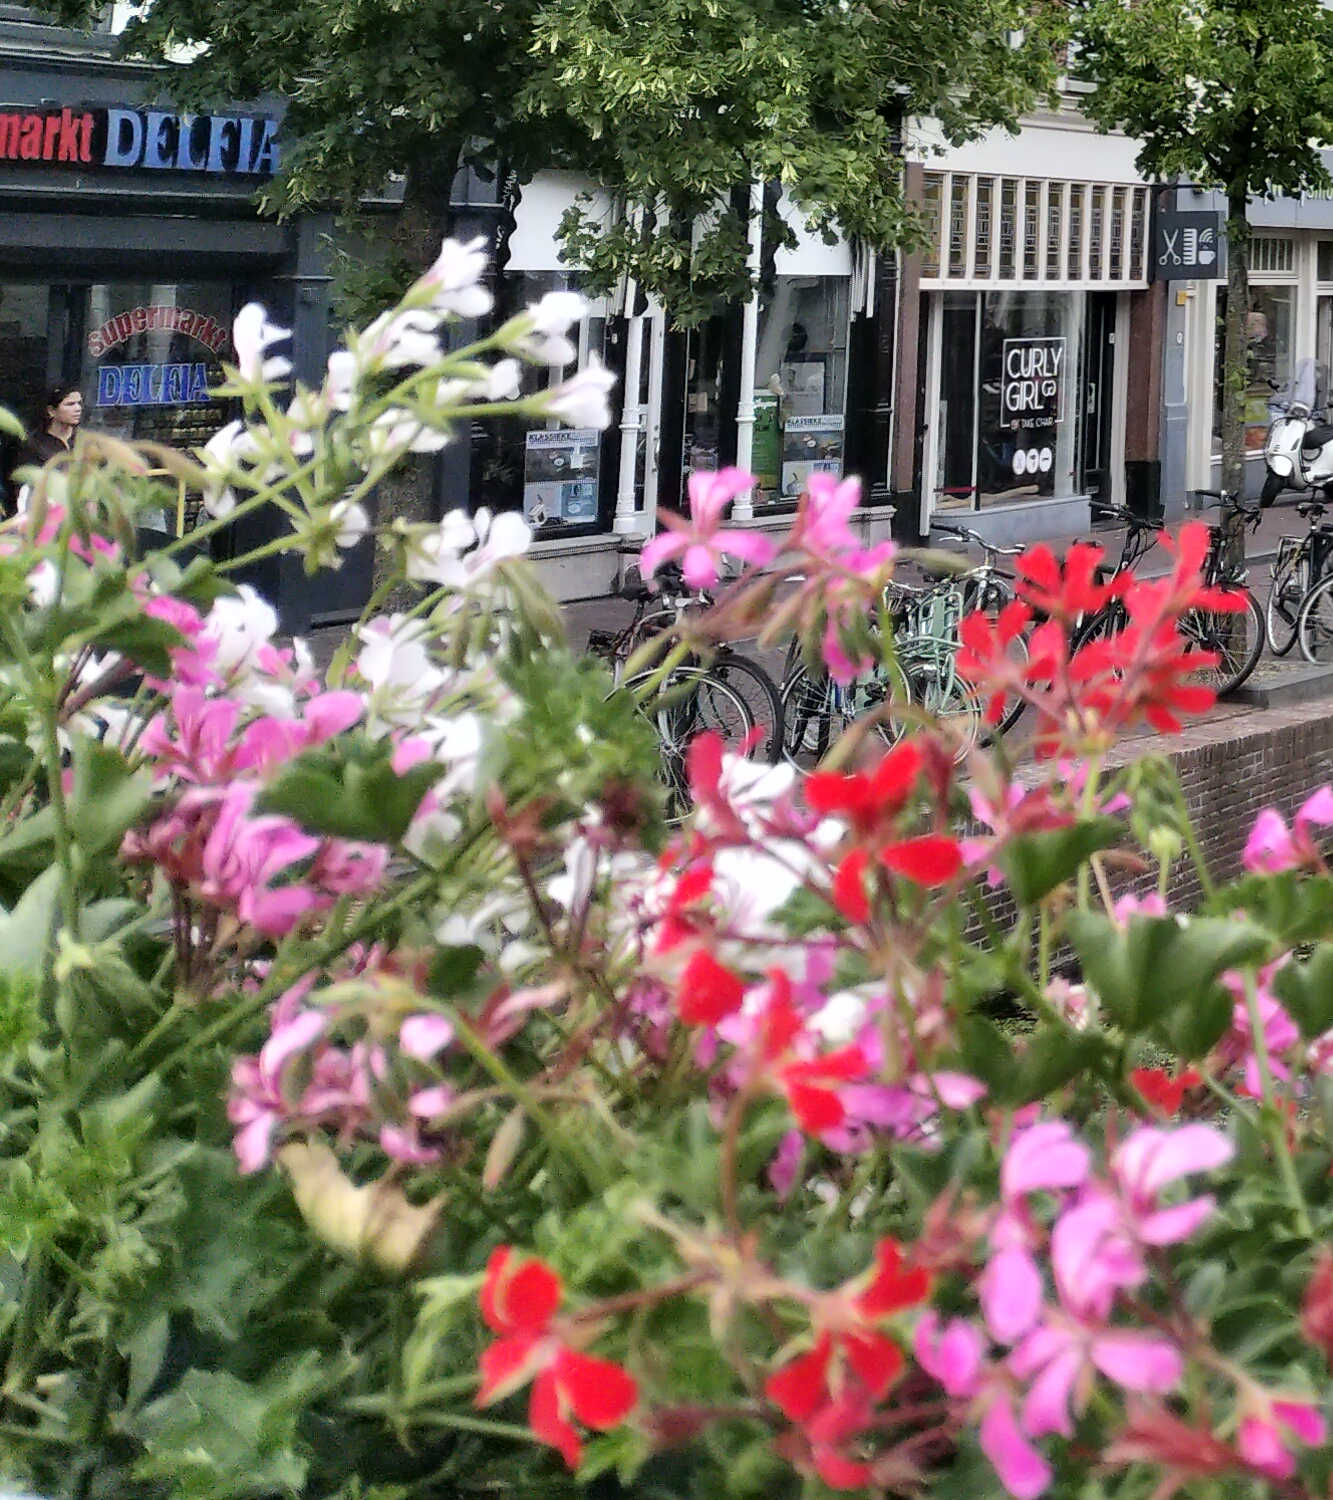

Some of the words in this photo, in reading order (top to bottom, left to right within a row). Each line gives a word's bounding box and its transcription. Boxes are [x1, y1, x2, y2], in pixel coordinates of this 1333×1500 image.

[102, 108, 282, 175] DELFIA
[88, 304, 228, 357] supermarkt
[96, 362, 212, 407] DELFIA
[1007, 347, 1063, 379] CURLY
[1005, 380, 1044, 412] GIRL
